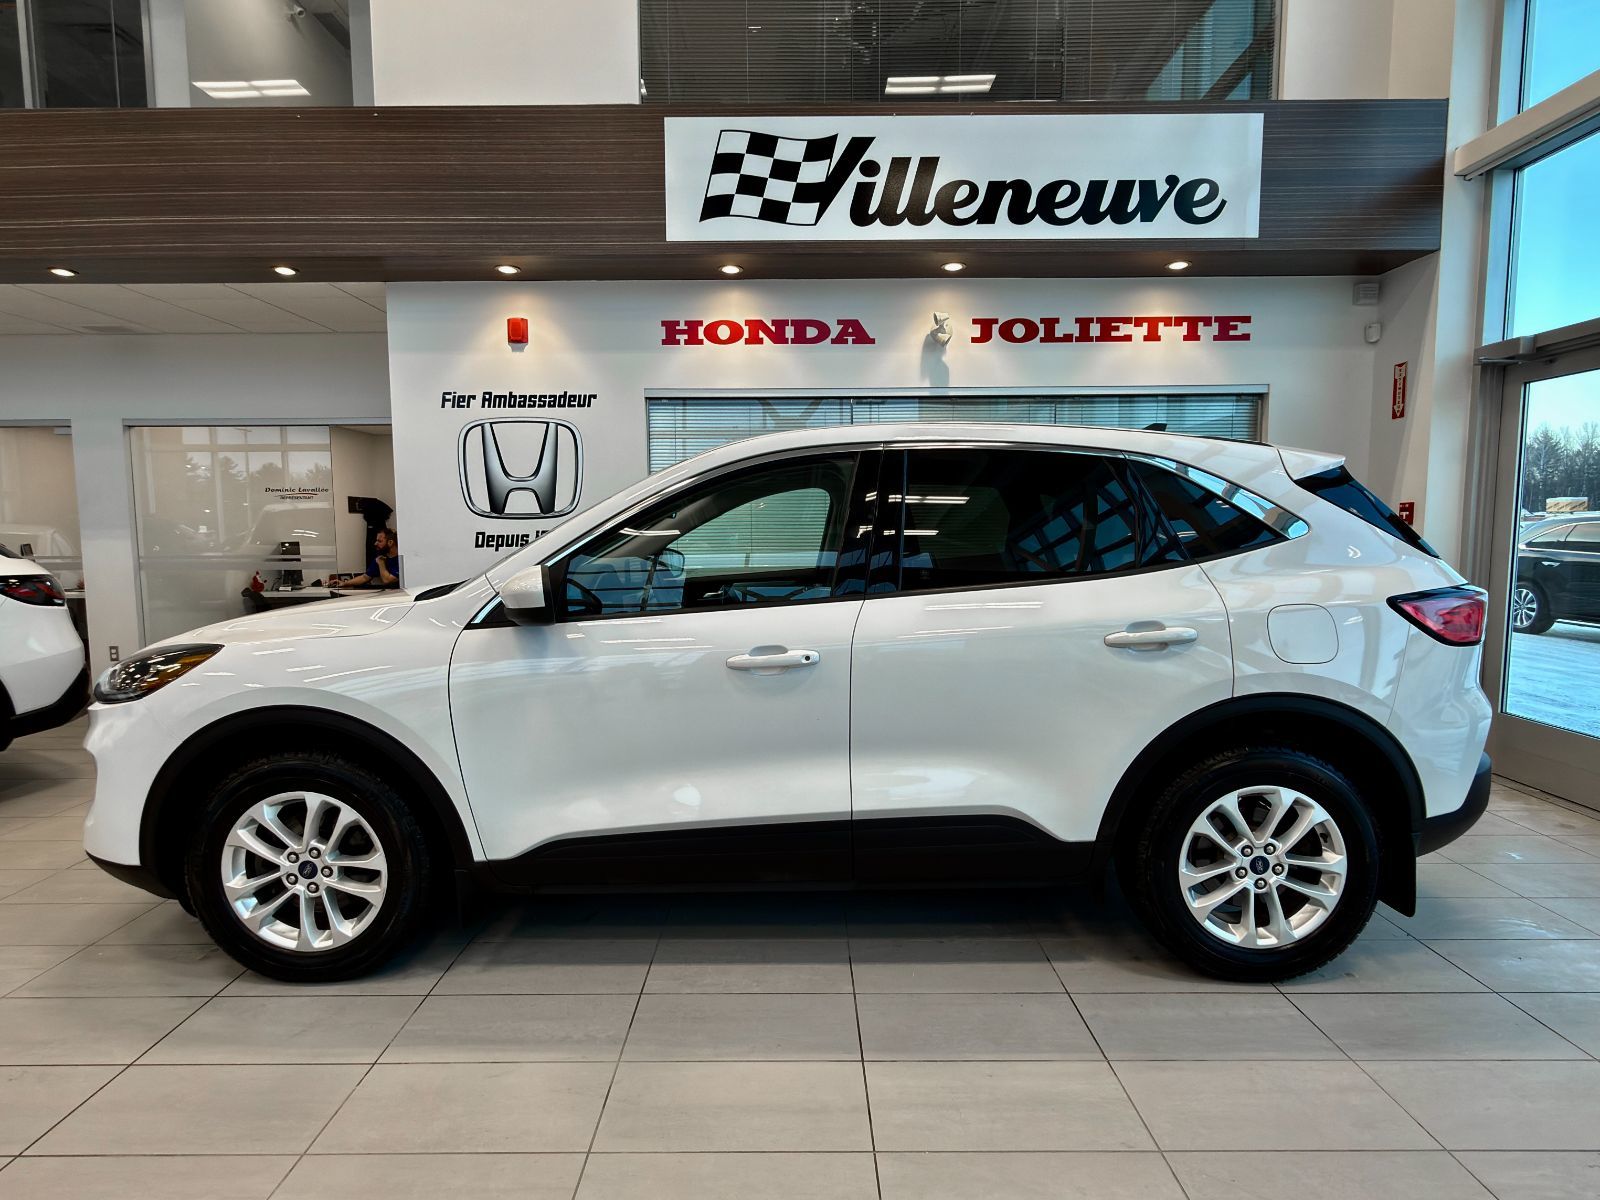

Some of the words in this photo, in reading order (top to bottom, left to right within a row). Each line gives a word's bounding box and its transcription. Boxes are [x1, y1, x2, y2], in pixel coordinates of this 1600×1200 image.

[699, 130, 1228, 228] Villeneuve
[661, 318, 876, 346] HONDA
[971, 315, 1252, 344] JOLIETTE
[441, 391, 477, 409] Fier
[481, 391, 598, 409] Ambassadeur
[475, 531, 530, 552] Depuis
